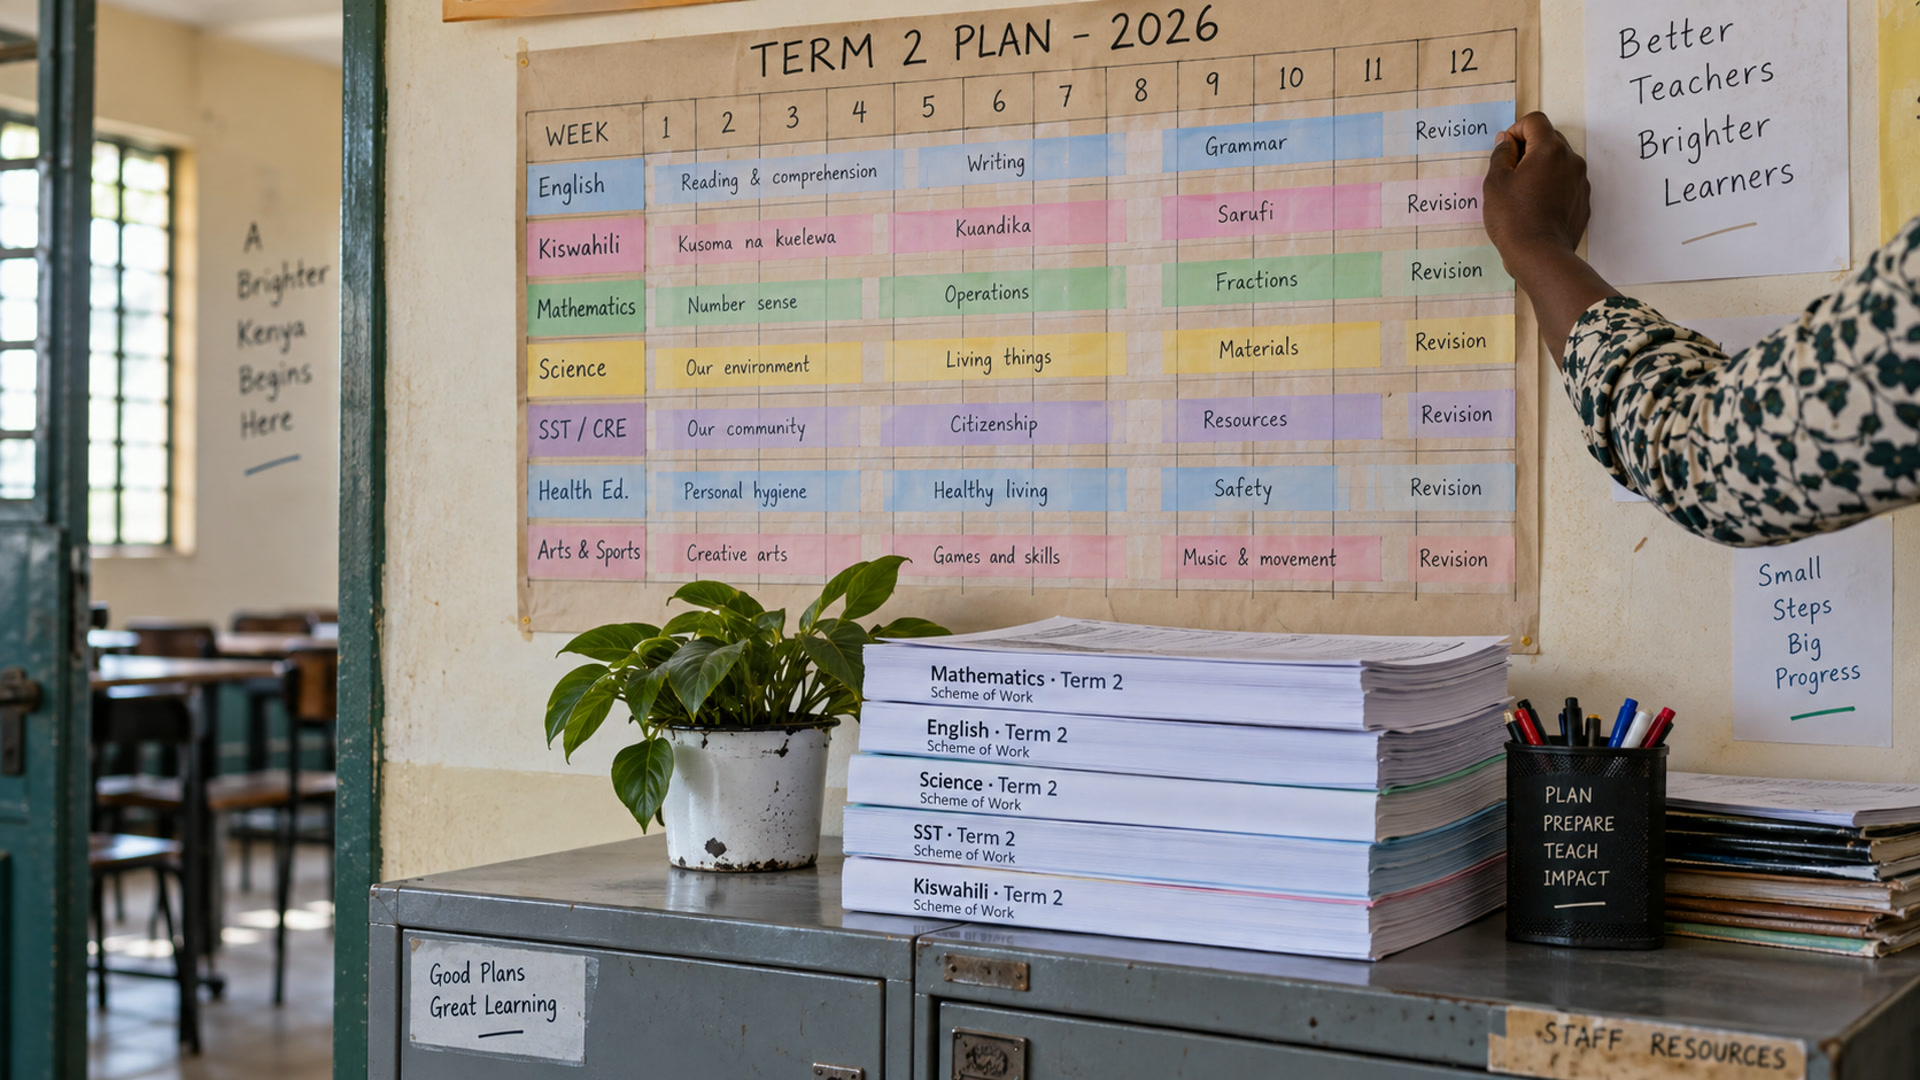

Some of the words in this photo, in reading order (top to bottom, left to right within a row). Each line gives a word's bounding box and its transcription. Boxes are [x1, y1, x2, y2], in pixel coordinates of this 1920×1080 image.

[750, 33, 874, 78] TERM
[902, 29, 927, 67] 2
[954, 18, 1051, 61] PLAN
[1110, 4, 1219, 51] 2026
[1619, 17, 1734, 60] Better
[1629, 61, 1774, 105] Teachers
[545, 121, 609, 147] WEEK
[662, 115, 670, 139] 1
[721, 111, 736, 134] 2
[786, 105, 799, 129] 3
[852, 100, 867, 124] 4
[922, 94, 935, 118] 5
[993, 89, 1006, 113] 6
[1059, 84, 1073, 108] 7
[1134, 77, 1148, 102] 8
[1206, 71, 1219, 96] 9
[1279, 66, 1304, 90] 10
[1364, 57, 1383, 83] 11
[1450, 47, 1478, 75] 12
[1416, 118, 1488, 141] Revision
[1637, 114, 1771, 165] Brighter
[1205, 135, 1288, 157] Grammar
[967, 151, 1025, 178] Writing
[539, 171, 605, 206] English
[681, 169, 738, 196] Reading
[750, 167, 761, 186] &
[772, 163, 877, 190] comprehension
[1664, 163, 1794, 207] Learners
[1218, 199, 1274, 224] Sarufi
[1408, 192, 1478, 214] Revision
[244, 222, 262, 252] A
[956, 214, 1032, 238] Kuandika
[539, 232, 620, 260] Kiswahili
[678, 234, 733, 253] Kusoma
[745, 237, 764, 249] na
[775, 226, 837, 248] kuelewa
[237, 260, 329, 307] Brighter
[1216, 270, 1298, 292] Fractions
[1411, 261, 1483, 281] Revision
[537, 295, 636, 320] Mathematics
[688, 293, 746, 315] Number
[757, 297, 798, 311] sense
[945, 282, 1030, 310] Operations
[237, 320, 305, 354] Kenya
[1219, 335, 1299, 359] Materials
[1415, 331, 1487, 352] Revision
[539, 357, 607, 380] Science
[686, 358, 714, 377] Our
[724, 354, 810, 375] environment
[946, 350, 992, 376] Living
[1003, 346, 1052, 373] things
[239, 361, 312, 402] Begins
[241, 409, 294, 440] Here
[950, 412, 1038, 439] Citizenship
[1204, 409, 1288, 429] Resources
[1421, 404, 1493, 425] Revision
[538, 418, 572, 440] SST
[577, 416, 587, 442] /
[593, 417, 627, 439] CRE
[687, 419, 716, 438] Our
[726, 416, 806, 442] community
[539, 478, 592, 501] Health
[602, 477, 629, 500] Ed.
[684, 480, 743, 500] Personal
[753, 480, 807, 508] hygiene
[934, 479, 994, 508] Healthy
[1006, 478, 1048, 507] living
[1214, 476, 1273, 506] Safety
[1410, 477, 1482, 497] Revision
[537, 539, 572, 560] Arts
[578, 539, 589, 559] &
[596, 539, 641, 568] Sports
[687, 543, 748, 562] Creative
[757, 544, 788, 563] arts
[933, 545, 981, 565] Games
[989, 544, 1015, 564] and
[1024, 546, 1061, 565] skills
[1183, 547, 1228, 566] Music
[1237, 547, 1249, 566] &
[1260, 548, 1337, 567] movement
[1419, 548, 1488, 568] Revision
[1758, 555, 1821, 587] Small
[1773, 597, 1832, 625] Steps
[1787, 632, 1821, 662] Big
[931, 665, 1045, 687] Mathematics
[1060, 671, 1106, 689] Term
[1112, 673, 1124, 691] 2
[1775, 664, 1861, 695] Progress
[930, 685, 980, 701] Scheme
[982, 688, 997, 701] of
[999, 689, 1033, 703] Work
[927, 718, 989, 743] English
[1004, 723, 1051, 742] Term
[1057, 726, 1068, 744] 2
[927, 739, 976, 755] Scheme
[978, 743, 992, 756] of
[995, 744, 1030, 759] Work
[919, 771, 983, 792] Science
[997, 776, 1041, 795] Term
[1047, 780, 1058, 797] 2
[1545, 785, 1592, 804] PLAN
[920, 791, 968, 807] Scheme
[971, 795, 985, 809] of
[987, 797, 1022, 811] Work
[913, 823, 944, 841] SST
[956, 826, 1000, 846] Term
[1005, 830, 1015, 847] 2
[1543, 814, 1615, 832] PREPARE
[914, 843, 963, 860] Scheme
[965, 848, 980, 861] of
[982, 849, 1016, 864] Work
[1543, 842, 1598, 859] TEACH
[1543, 869, 1610, 887] IMPACT
[914, 877, 989, 900] Kiswahili
[1003, 885, 1047, 905] Term
[1052, 889, 1063, 906] 2
[913, 898, 962, 914] Scheme
[964, 903, 978, 916] of
[980, 904, 1015, 919] Work
[429, 960, 471, 987] Good
[480, 960, 526, 984] Plans
[430, 994, 477, 1019] Great
[485, 993, 557, 1023] Learning
[1543, 1020, 1623, 1052] STAFF
[1649, 1032, 1787, 1070] RESOURCES
